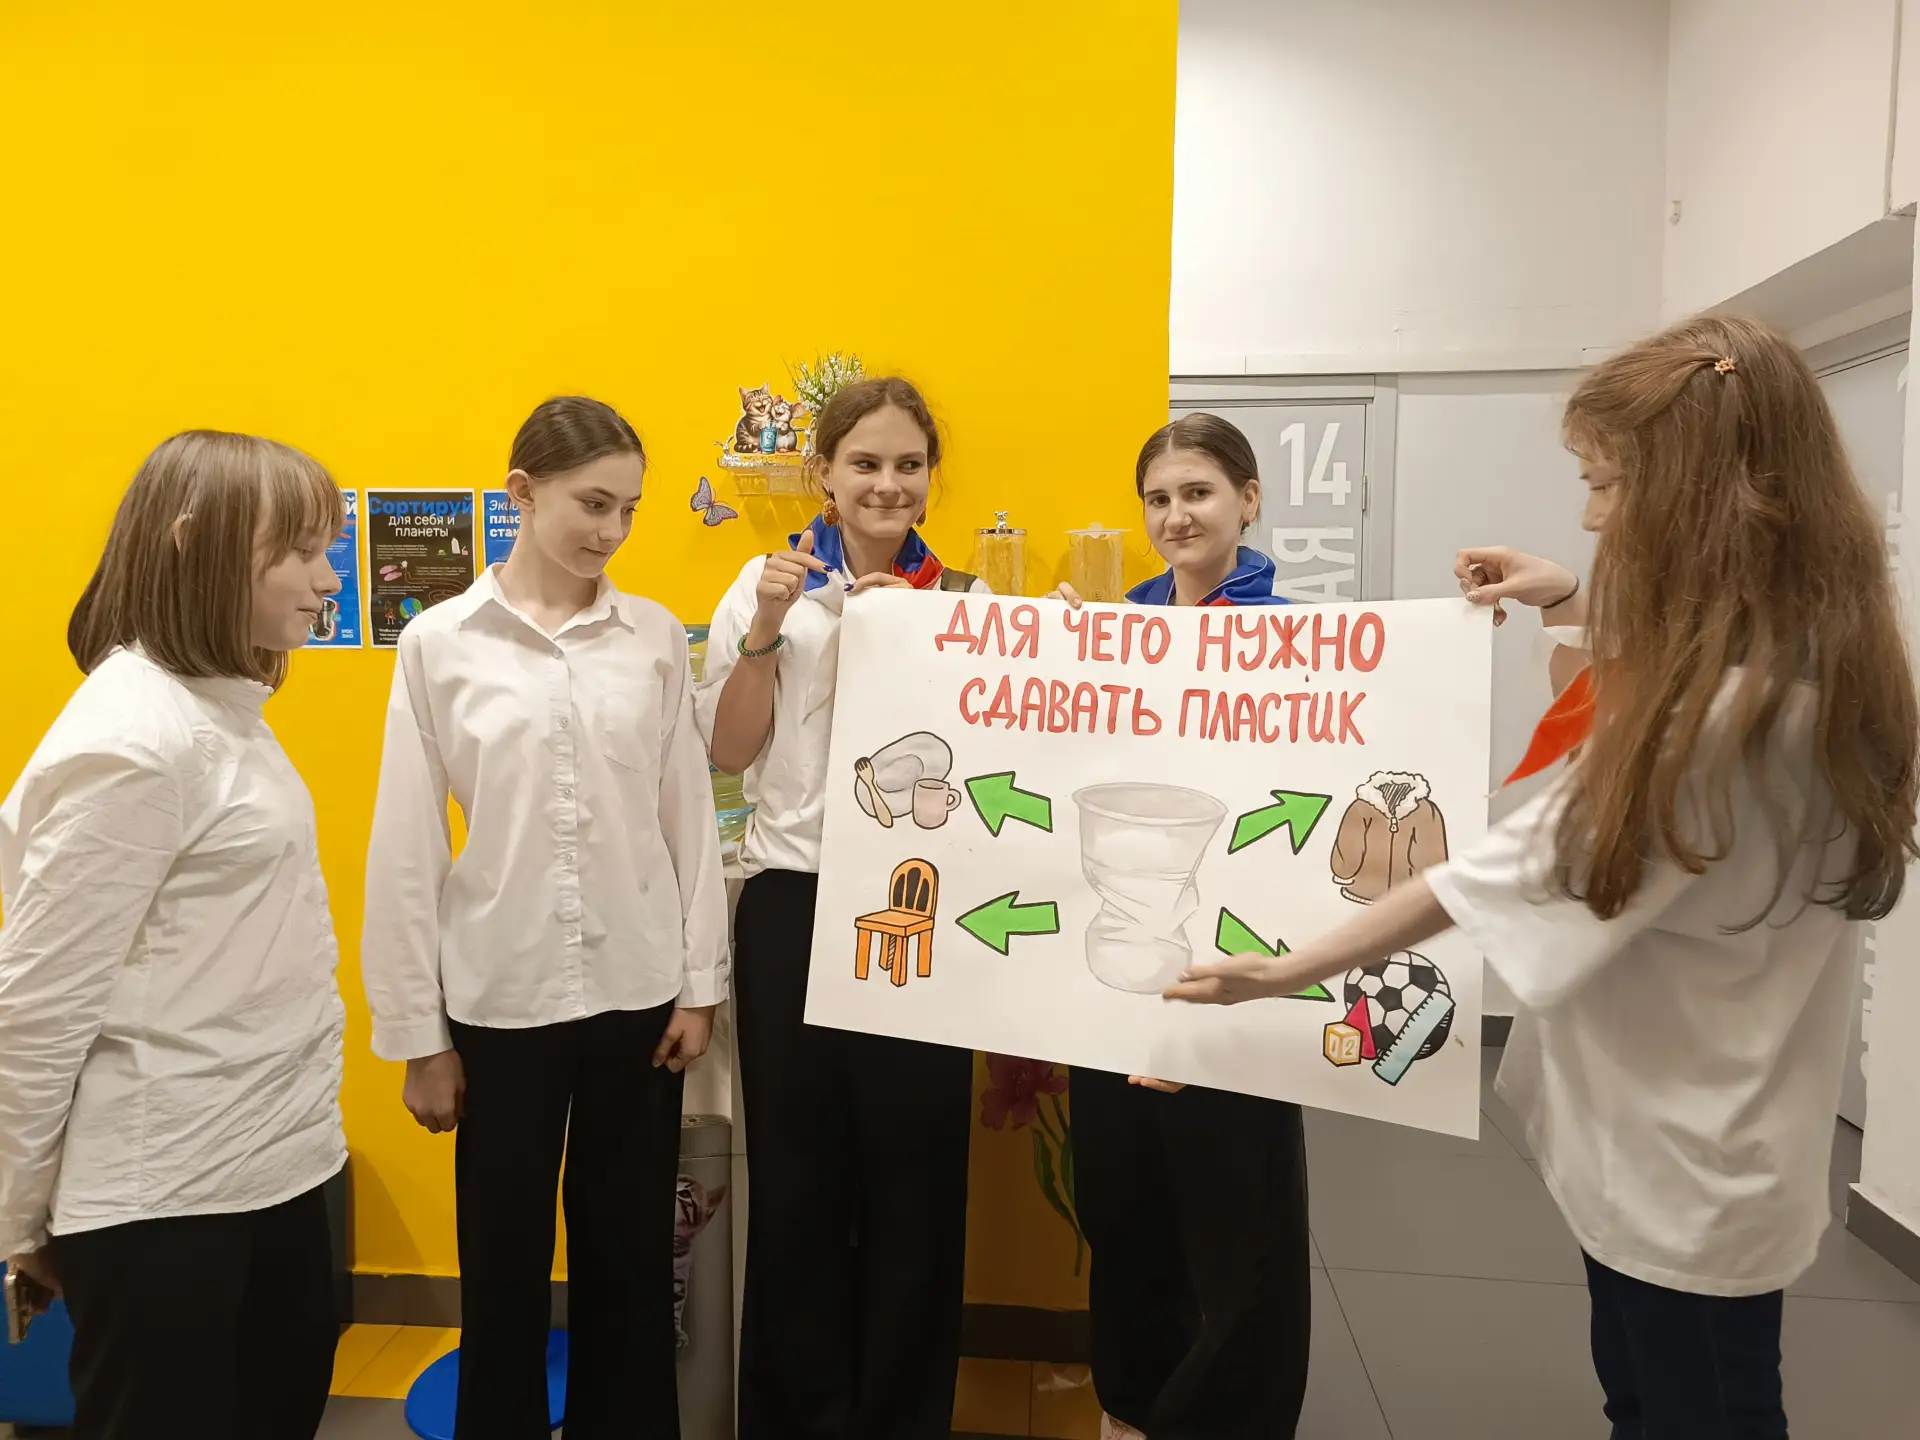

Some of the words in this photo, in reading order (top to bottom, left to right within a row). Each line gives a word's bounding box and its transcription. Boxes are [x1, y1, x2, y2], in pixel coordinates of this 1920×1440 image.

[1279, 422, 1352, 506] 14
[368, 495, 473, 519] Сортируй
[388, 515, 411, 527] для
[414, 513, 443, 526] себя
[447, 515, 456, 526] и
[489, 515, 521, 525] плас
[395, 527, 449, 538] планеты
[489, 528, 519, 538] стак
[933, 600, 1040, 659] ДЛЯ
[1063, 608, 1172, 665] ЧЕГО
[1196, 611, 1386, 673] НУЖНО
[959, 675, 1162, 736] СДАВАТЬ
[1178, 688, 1367, 745] ПЛАСТИК
